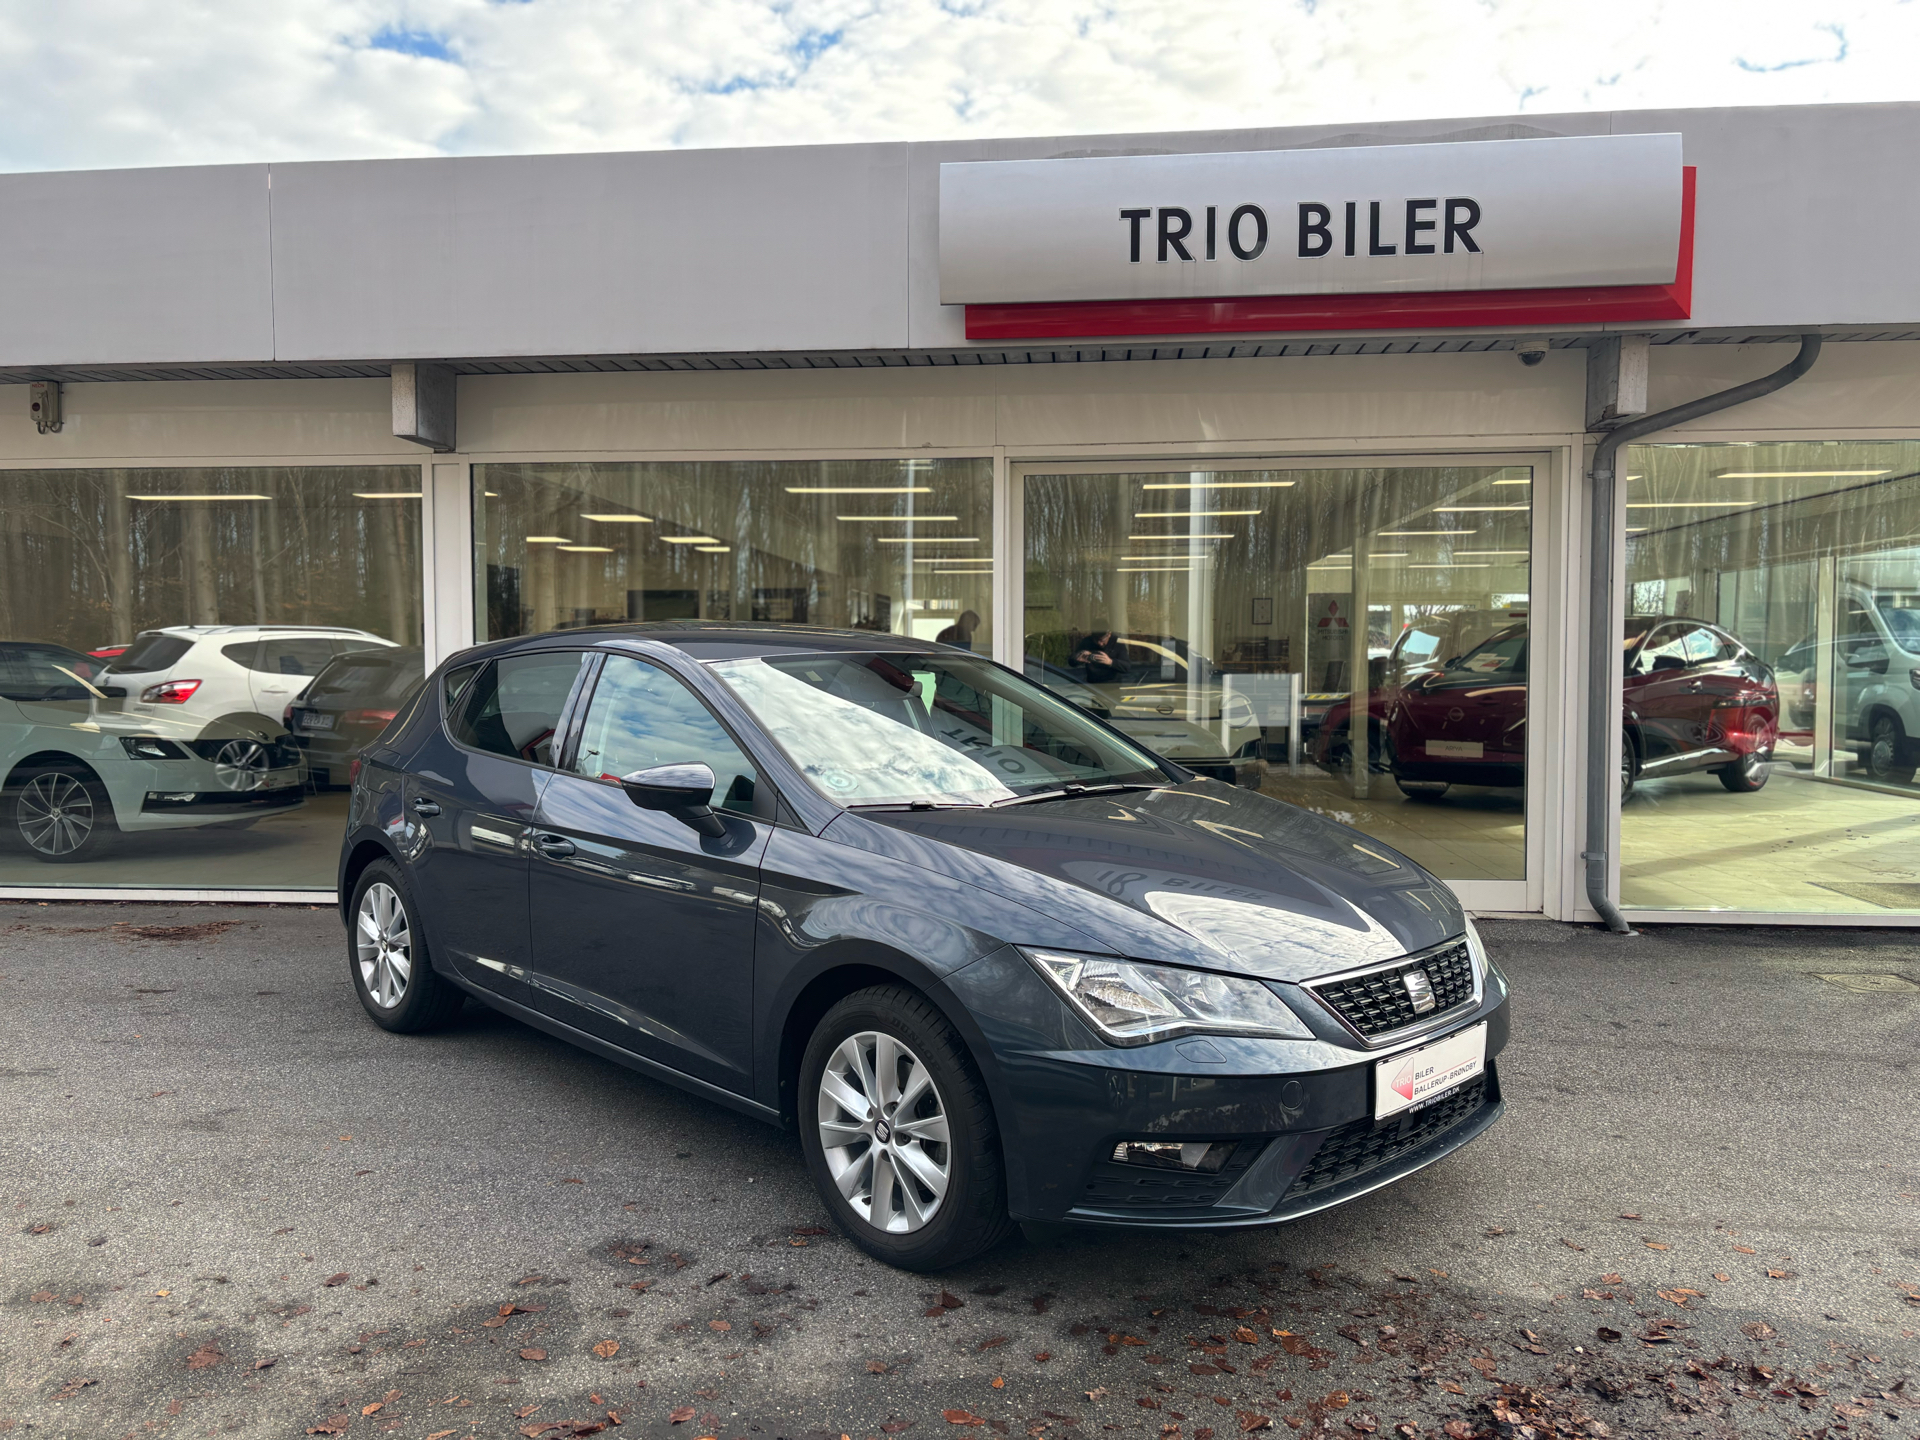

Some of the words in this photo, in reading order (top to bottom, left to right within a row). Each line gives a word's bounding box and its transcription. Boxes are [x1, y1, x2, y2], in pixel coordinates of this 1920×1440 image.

[1120, 204, 1268, 263] TRIO
[1297, 198, 1482, 259] BILER
[1395, 1075, 1412, 1089] TRIO
[1415, 1066, 1435, 1081] BILER
[1408, 1086, 1460, 1114] WWW.TRIOBILER.DK
